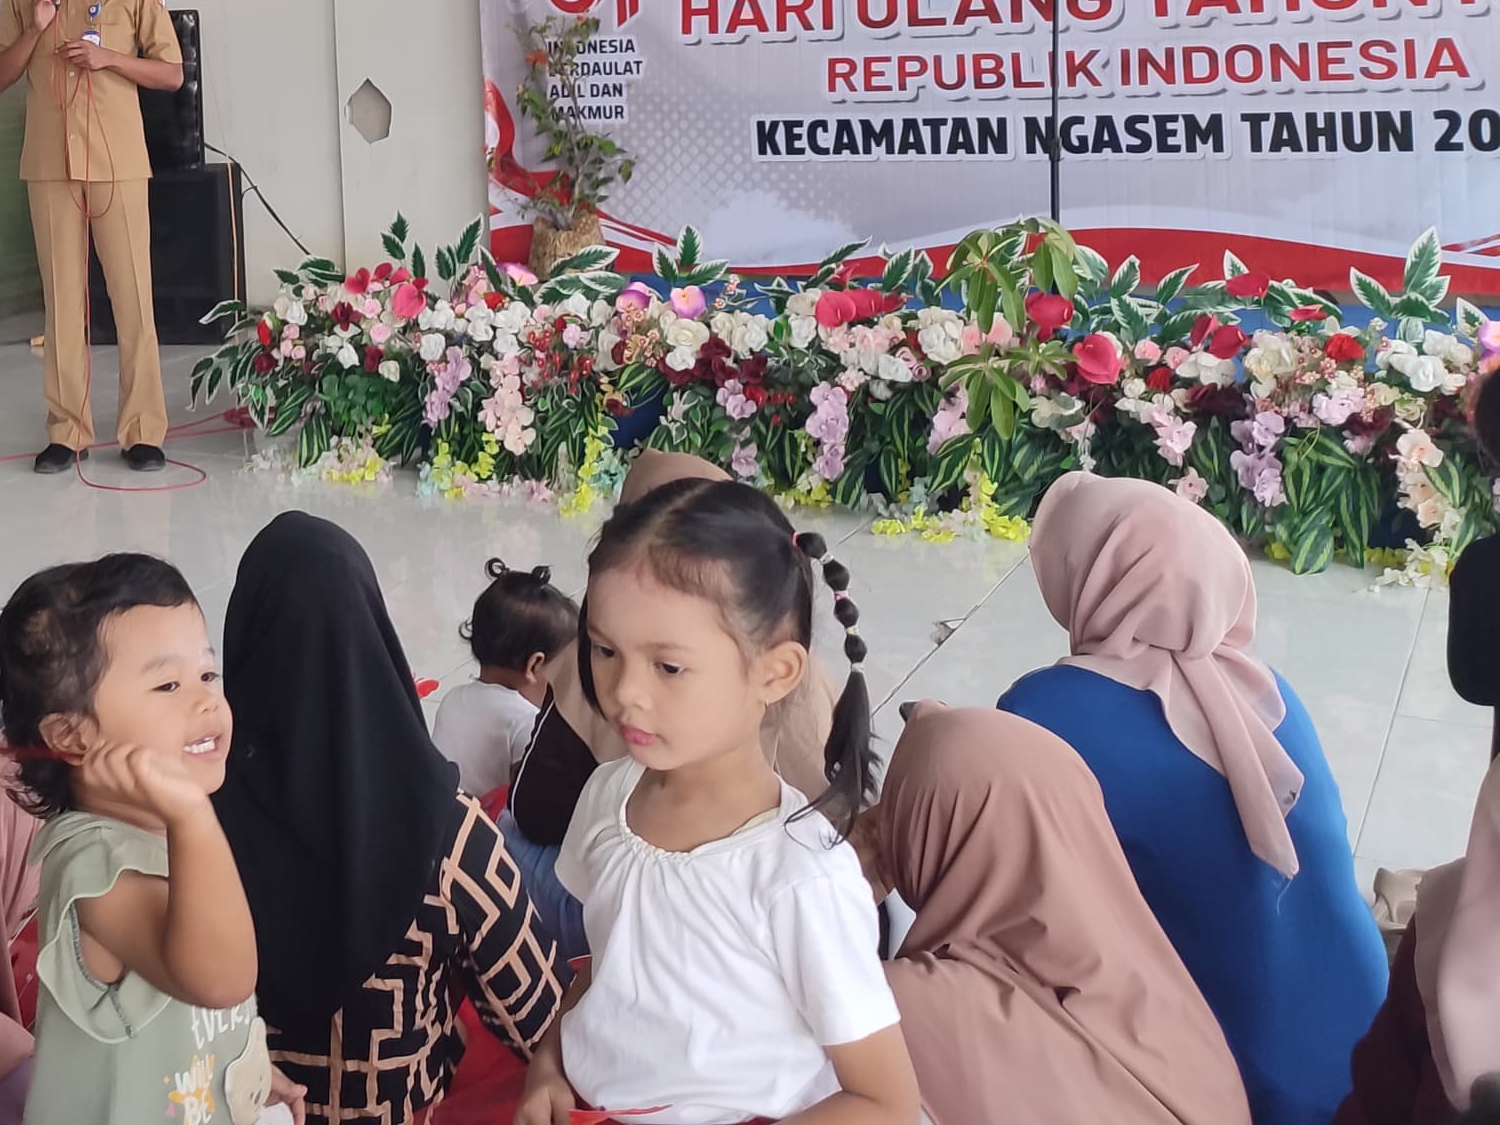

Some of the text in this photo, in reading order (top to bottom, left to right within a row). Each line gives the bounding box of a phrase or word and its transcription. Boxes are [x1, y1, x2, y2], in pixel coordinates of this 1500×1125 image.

[548, 38, 635, 55] INONESIA
[548, 60, 643, 77] RDAULAT
[1120, 37, 1471, 86] INDONESIA
[550, 82, 623, 98] ADL DAN
[756, 116, 1008, 156] KECAMATAN
[1024, 112, 1223, 156] NGASEM
[1241, 109, 1414, 153] TAHUN
